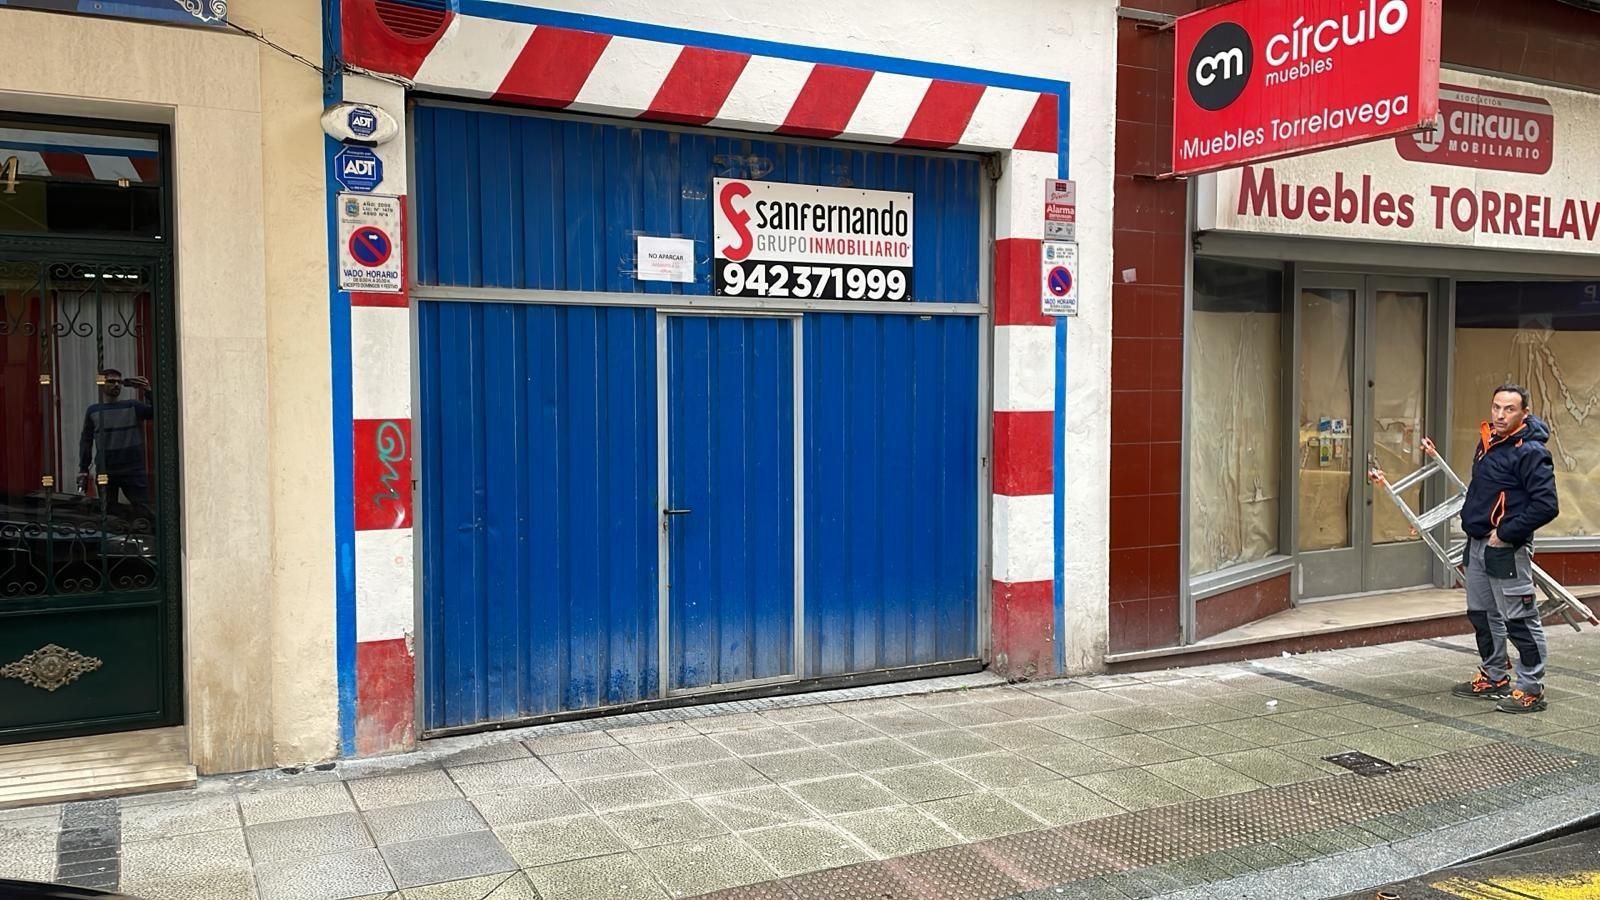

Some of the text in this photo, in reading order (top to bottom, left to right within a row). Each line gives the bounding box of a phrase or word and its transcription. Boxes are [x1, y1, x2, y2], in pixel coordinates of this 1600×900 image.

[1265, 0, 1408, 66] círculo
[1265, 56, 1333, 87] muebles
[352, 116, 373, 128] ADT
[1183, 95, 1408, 160] Muebles Torrelavega
[1449, 110, 1540, 143] CIRCULO
[1449, 139, 1540, 160] MOBILIARIO
[344, 159, 375, 176] ADT
[1237, 166, 1415, 229] Muebles
[1046, 204, 1075, 215] Alarma
[658, 253, 684, 261] APARCAR
[756, 234, 913, 258] GRUPO INMOBILIARIO
[343, 269, 398, 279] VADO HORARIO
